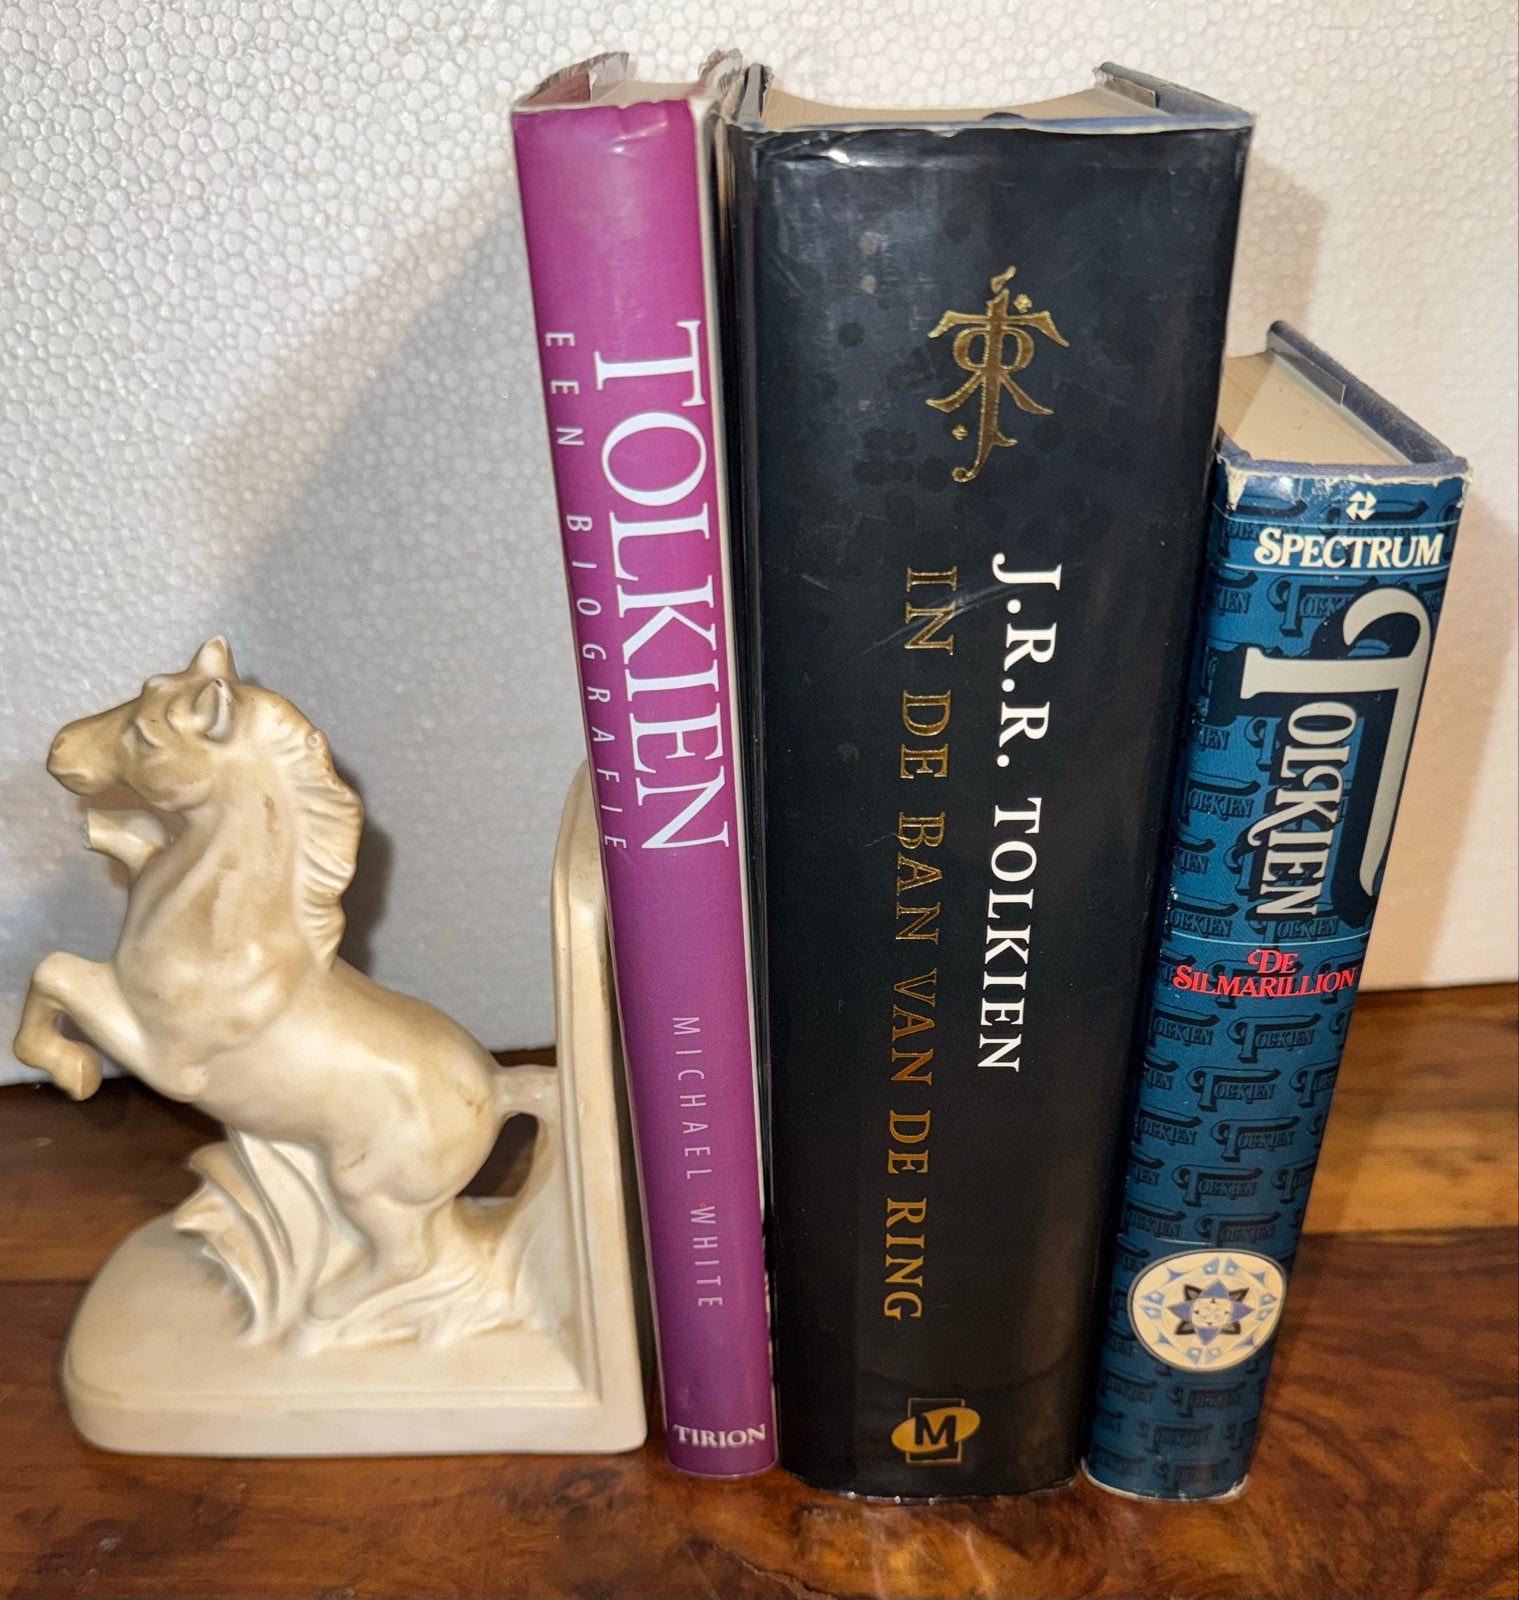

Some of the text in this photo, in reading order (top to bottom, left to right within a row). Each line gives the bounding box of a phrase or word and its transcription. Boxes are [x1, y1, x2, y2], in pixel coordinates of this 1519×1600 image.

[544, 331, 627, 850] EEN BIOGRAFIE
[594, 319, 730, 849] TOLKIEN
[1254, 527, 1444, 569] SPECTRUM
[977, 552, 1062, 1073] J.R.R. TOLKIEN
[1240, 588, 1432, 916] TOLKIEN
[883, 566, 957, 1321] IN DE BAN VAN DE RING
[1172, 964, 1357, 997] SILMARILLION
[1247, 949, 1298, 974] DE
[1186, 1066, 1281, 1112] TOLKIEN
[1227, 1014, 1322, 1063] TOLKIEN
[672, 1016, 722, 1307] MICHAEL WHITE
[673, 1423, 767, 1447] TIRION
